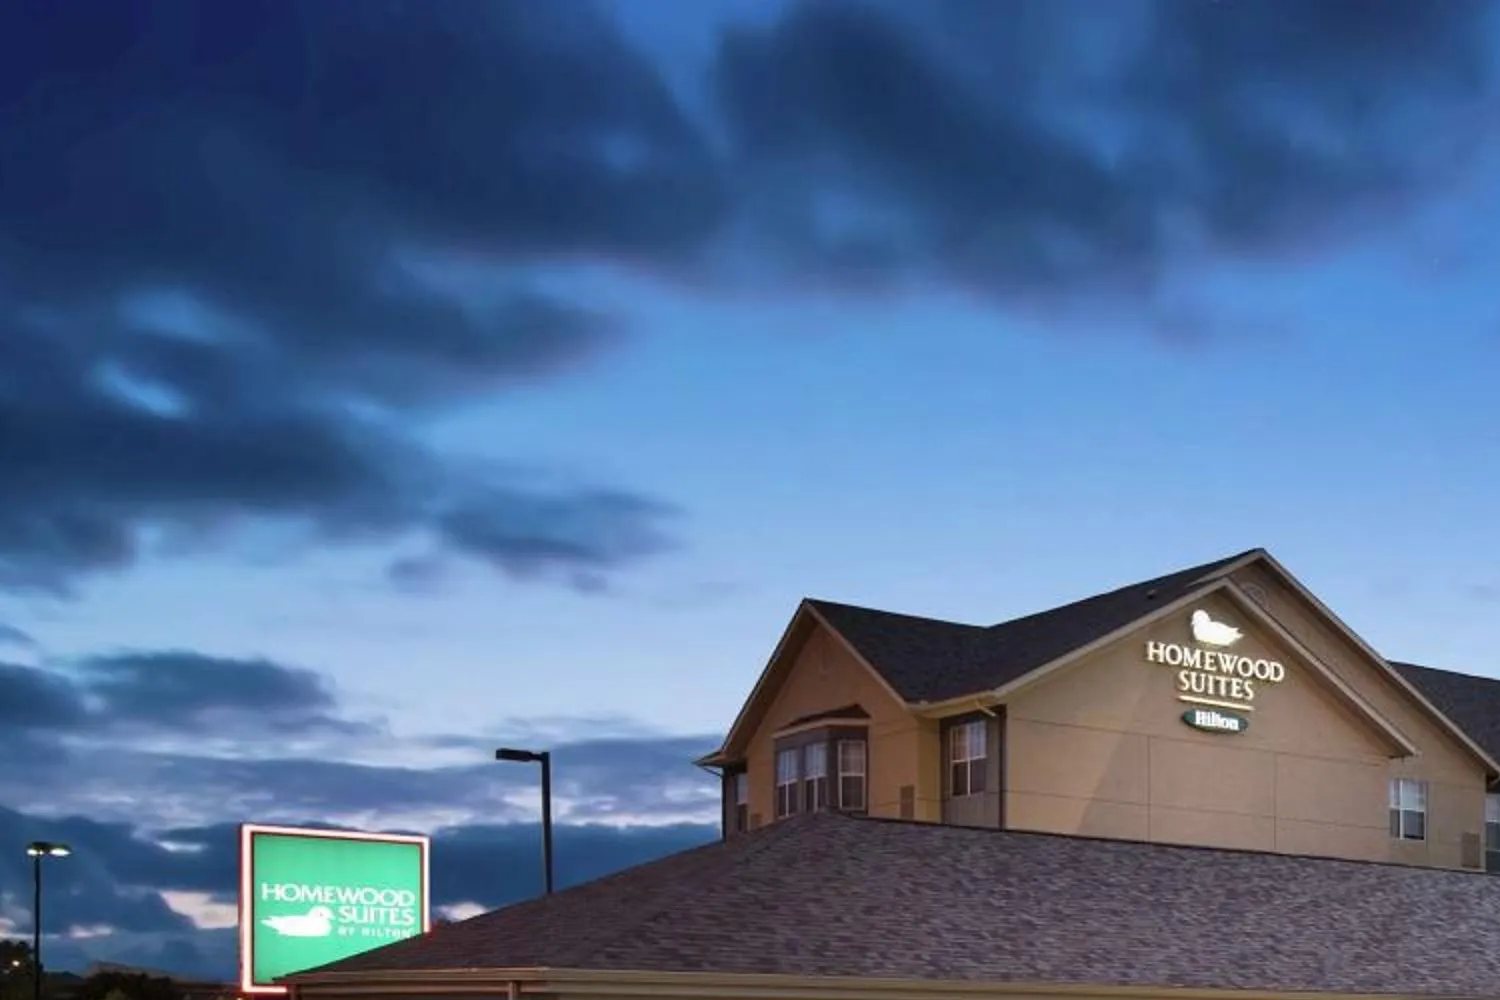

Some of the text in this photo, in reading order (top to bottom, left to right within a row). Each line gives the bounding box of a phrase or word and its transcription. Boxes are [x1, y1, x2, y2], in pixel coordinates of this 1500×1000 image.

[1147, 641, 1285, 682] HOMEWOOD
[1179, 670, 1254, 700] SUITES
[1195, 709, 1240, 731] Hilton
[261, 882, 416, 907] HOMEWOOD
[338, 905, 415, 926] SUITES
[338, 926, 355, 936] BY
